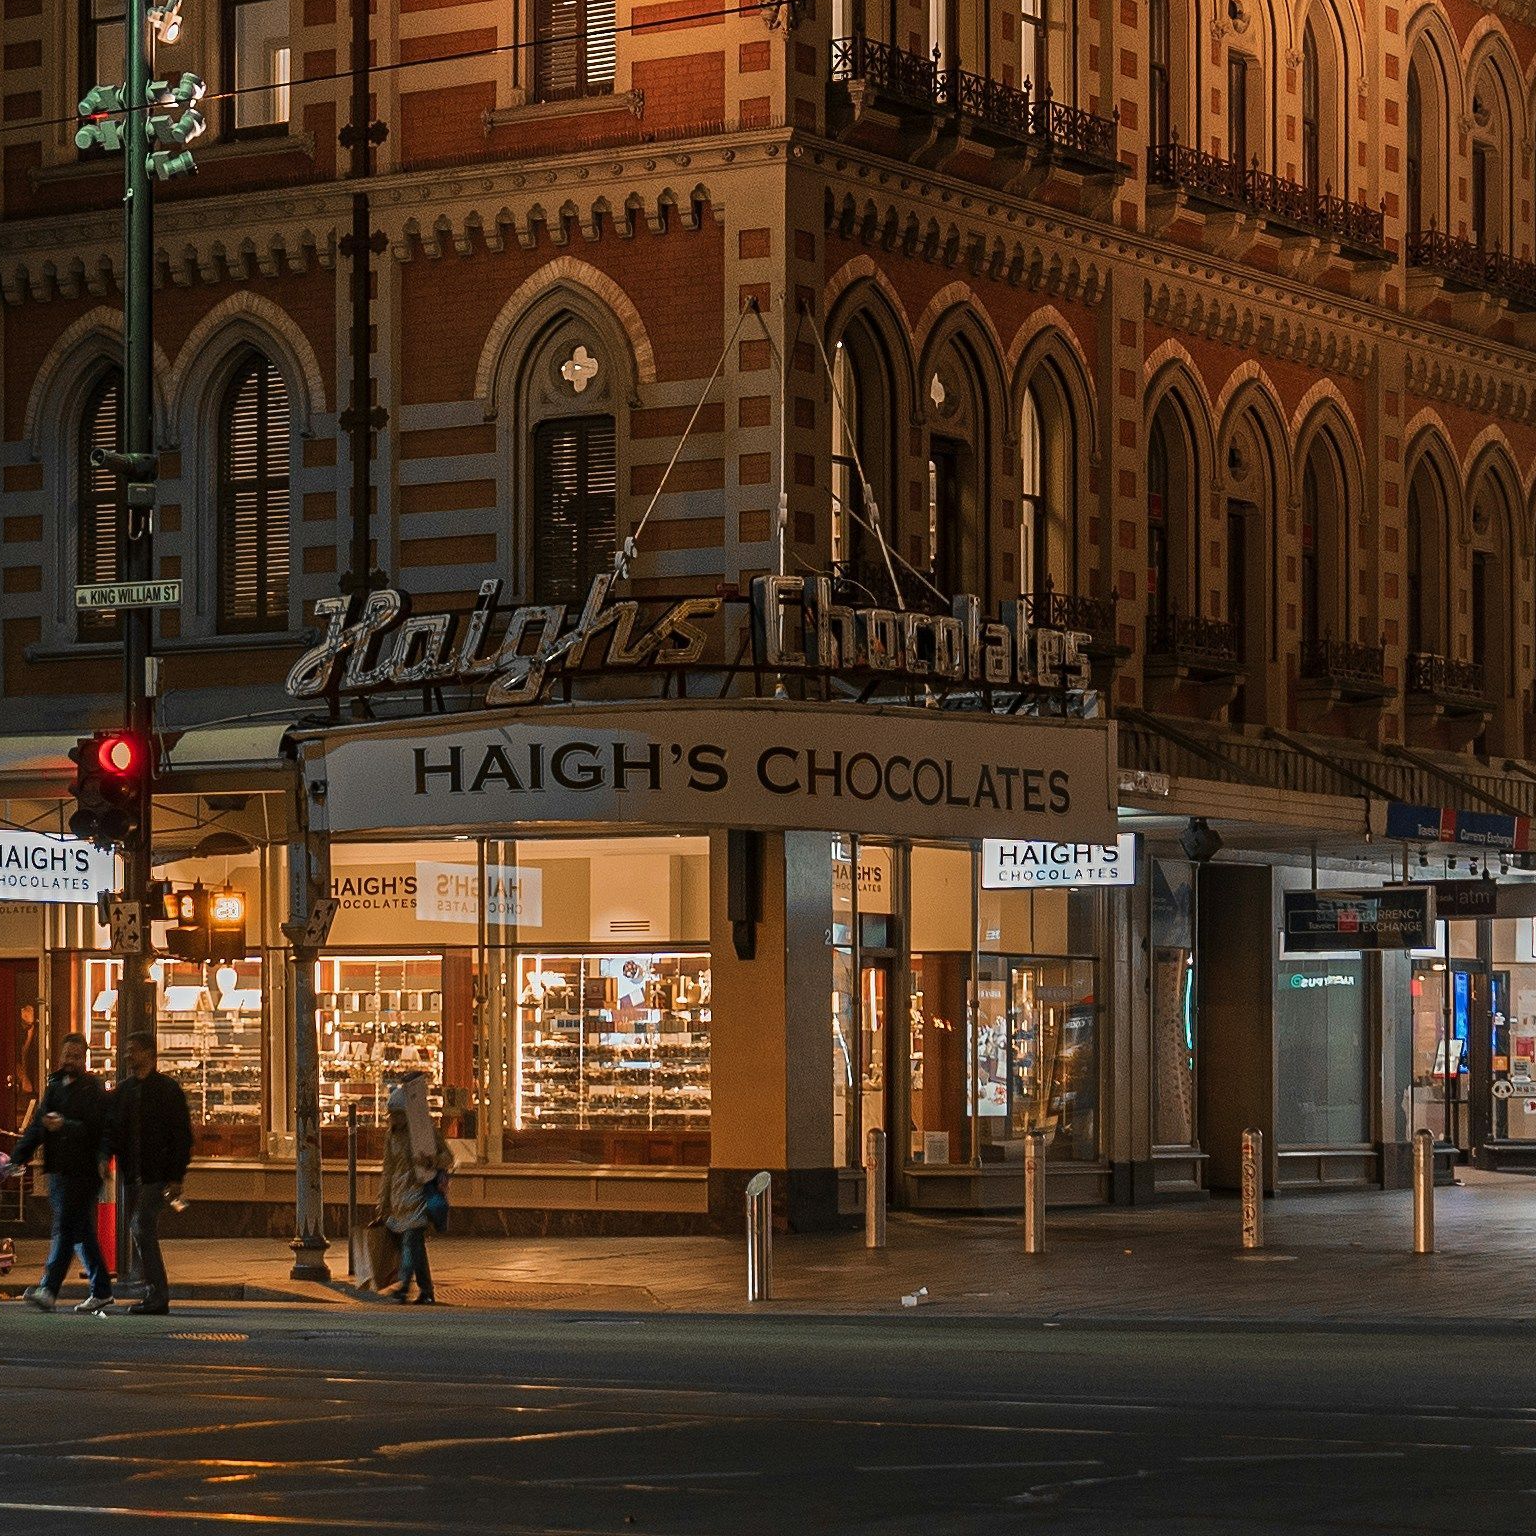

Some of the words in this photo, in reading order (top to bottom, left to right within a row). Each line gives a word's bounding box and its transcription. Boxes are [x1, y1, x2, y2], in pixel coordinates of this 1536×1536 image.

[90, 589, 116, 605] KING
[118, 586, 162, 603] WILLIAM
[163, 585, 178, 601] ST
[413, 741, 730, 797] HAIGH'S
[756, 746, 1072, 815] CHOCOLATES
[998, 844, 1119, 866] HAIGH'S
[998, 867, 1119, 882] CHOCOLATES
[338, 899, 418, 910] OCOLATES
[1362, 922, 1423, 933] EXCHANGE
